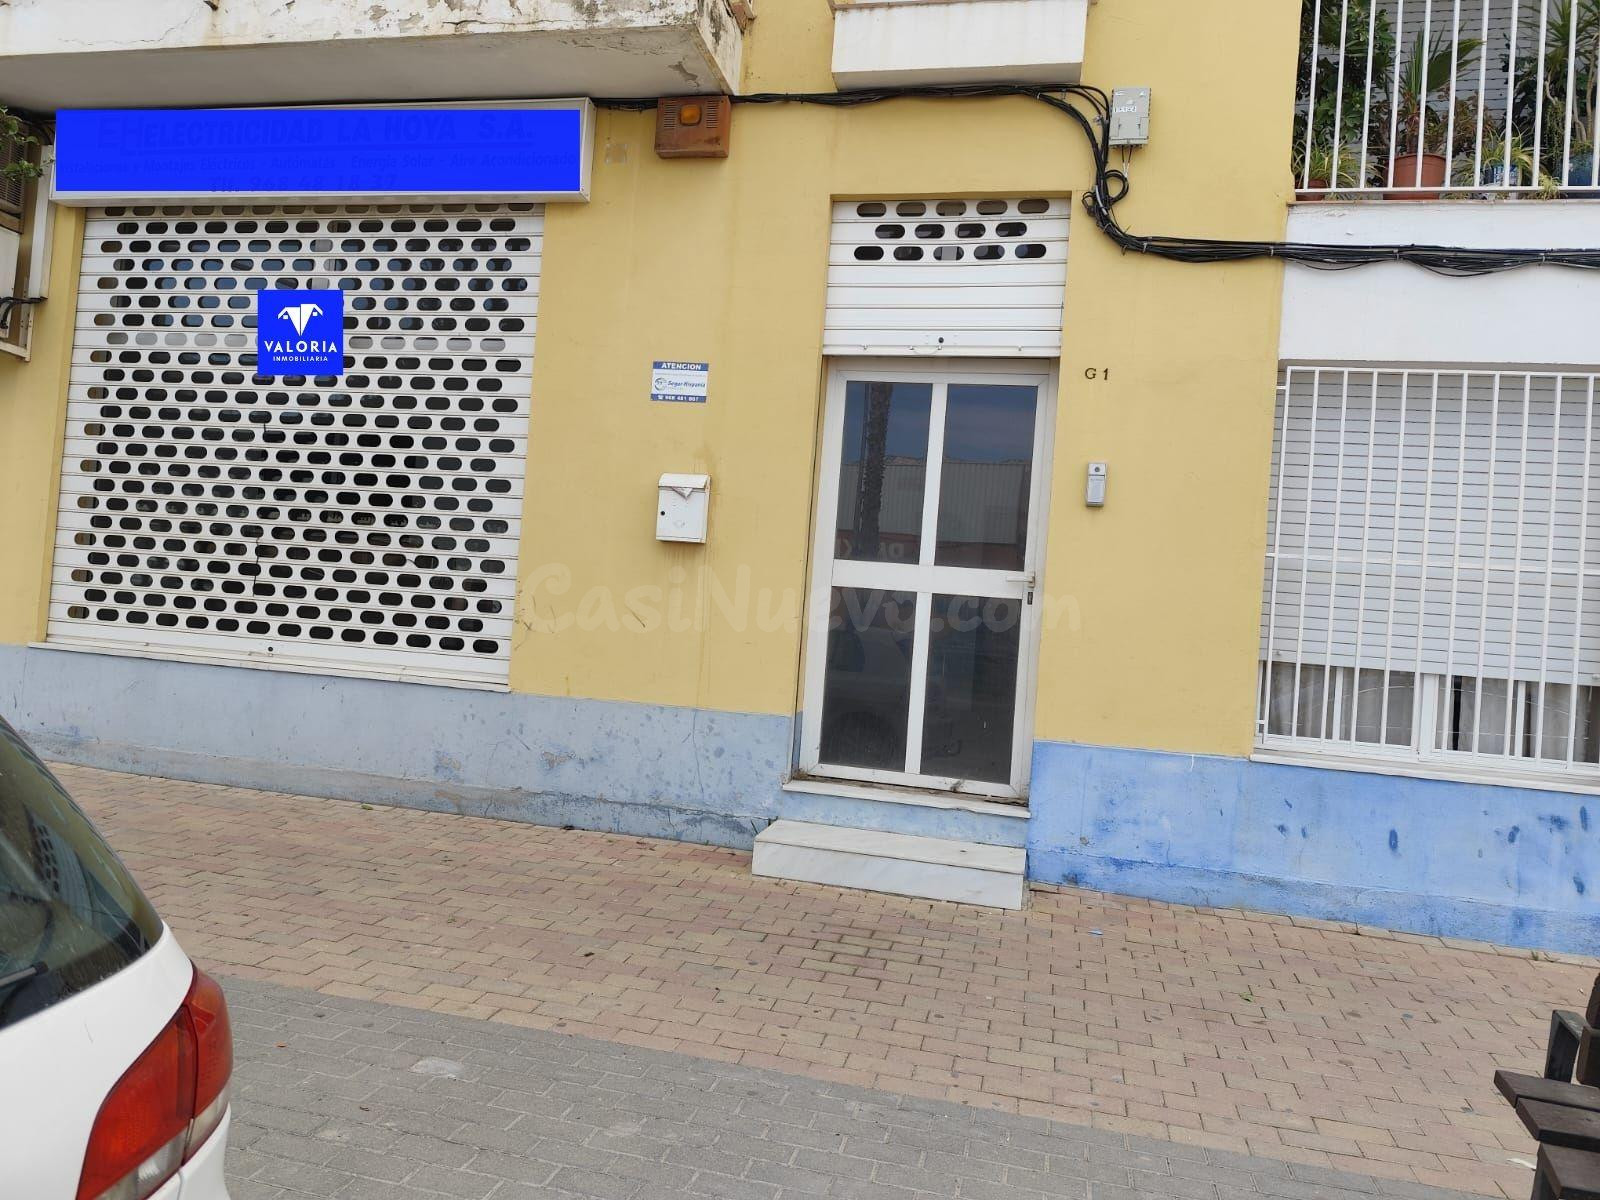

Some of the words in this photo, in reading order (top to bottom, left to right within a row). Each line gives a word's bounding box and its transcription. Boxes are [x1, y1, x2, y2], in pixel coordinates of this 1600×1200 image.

[338, 116, 371, 142] LA
[384, 114, 456, 141] HOYA
[661, 362, 702, 370] ATENCION
[1085, 367, 1097, 380] G
[1103, 367, 1109, 381] 1
